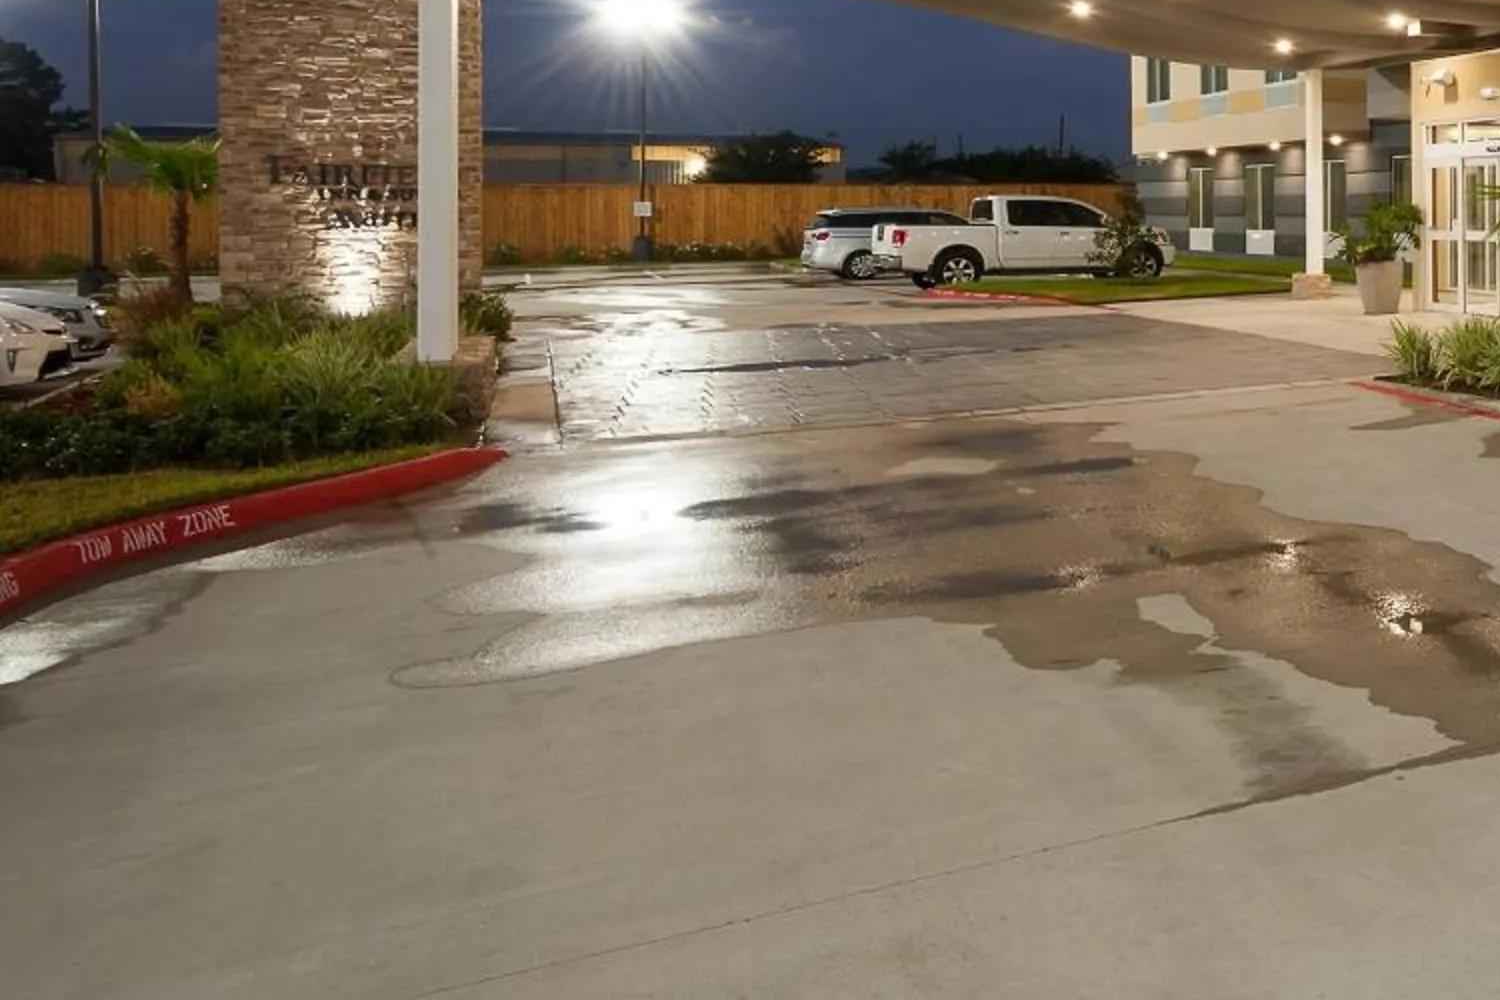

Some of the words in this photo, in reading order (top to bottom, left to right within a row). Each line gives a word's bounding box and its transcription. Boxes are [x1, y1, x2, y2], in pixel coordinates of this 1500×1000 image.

[266, 154, 419, 188] FAIRFIE
[77, 537, 113, 565] TOW
[122, 521, 169, 555] AWAY
[178, 504, 237, 538] ZONE
